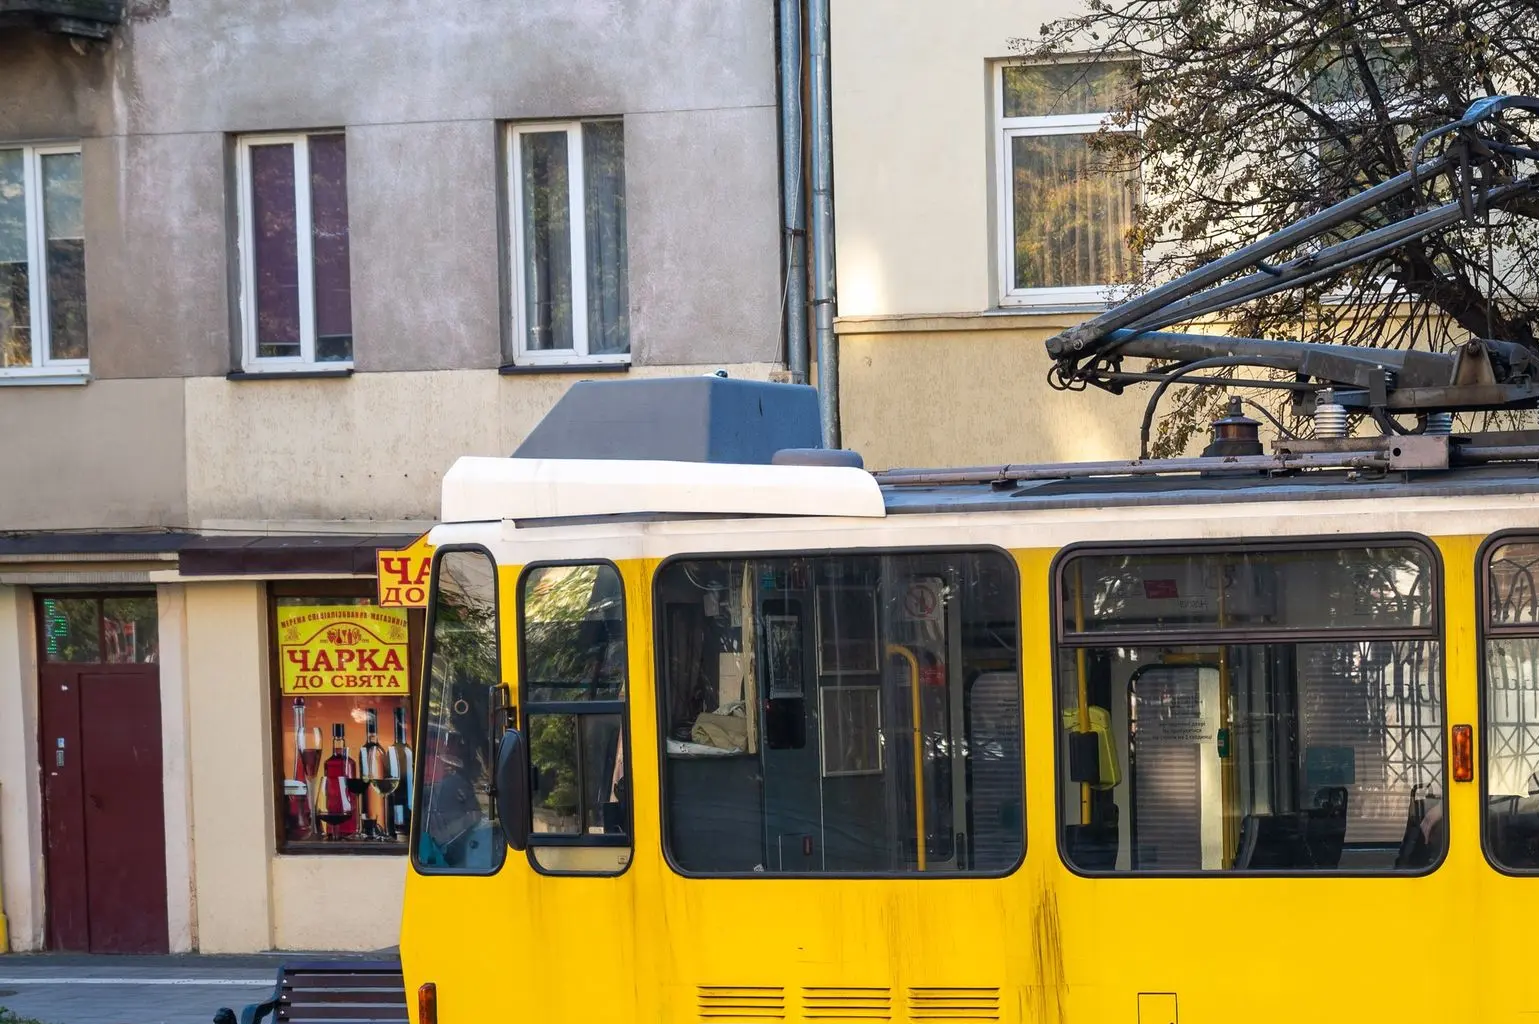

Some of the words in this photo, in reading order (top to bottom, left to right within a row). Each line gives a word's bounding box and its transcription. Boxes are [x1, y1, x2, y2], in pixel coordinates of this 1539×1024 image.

[382, 588, 425, 606] ДО
[287, 648, 404, 672] ЧАРКА
[293, 675, 324, 690] ДО
[331, 675, 401, 688] СВЯТА
